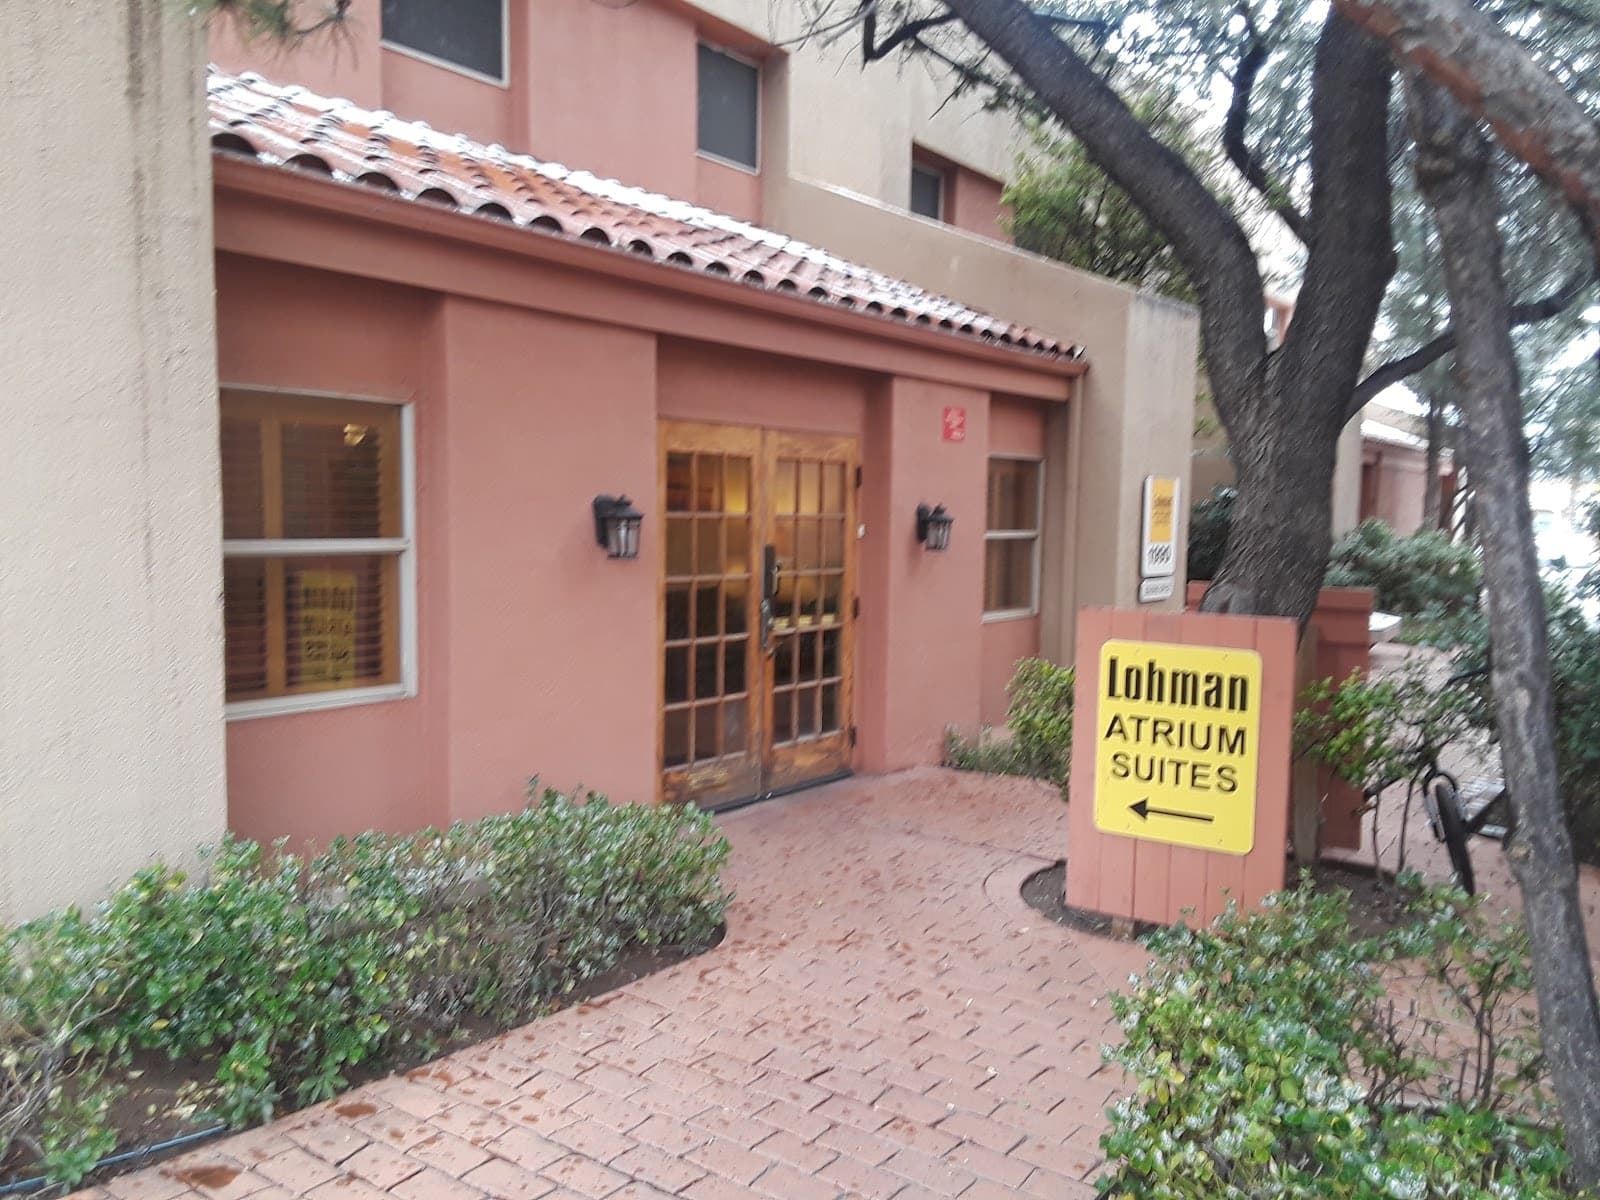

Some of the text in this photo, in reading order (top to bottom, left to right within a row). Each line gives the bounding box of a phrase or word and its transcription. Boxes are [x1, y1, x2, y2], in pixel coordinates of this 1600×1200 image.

[1107, 655, 1248, 712] Lohman
[1104, 712, 1247, 756] ATRIUM
[1111, 750, 1239, 793] SUITES
